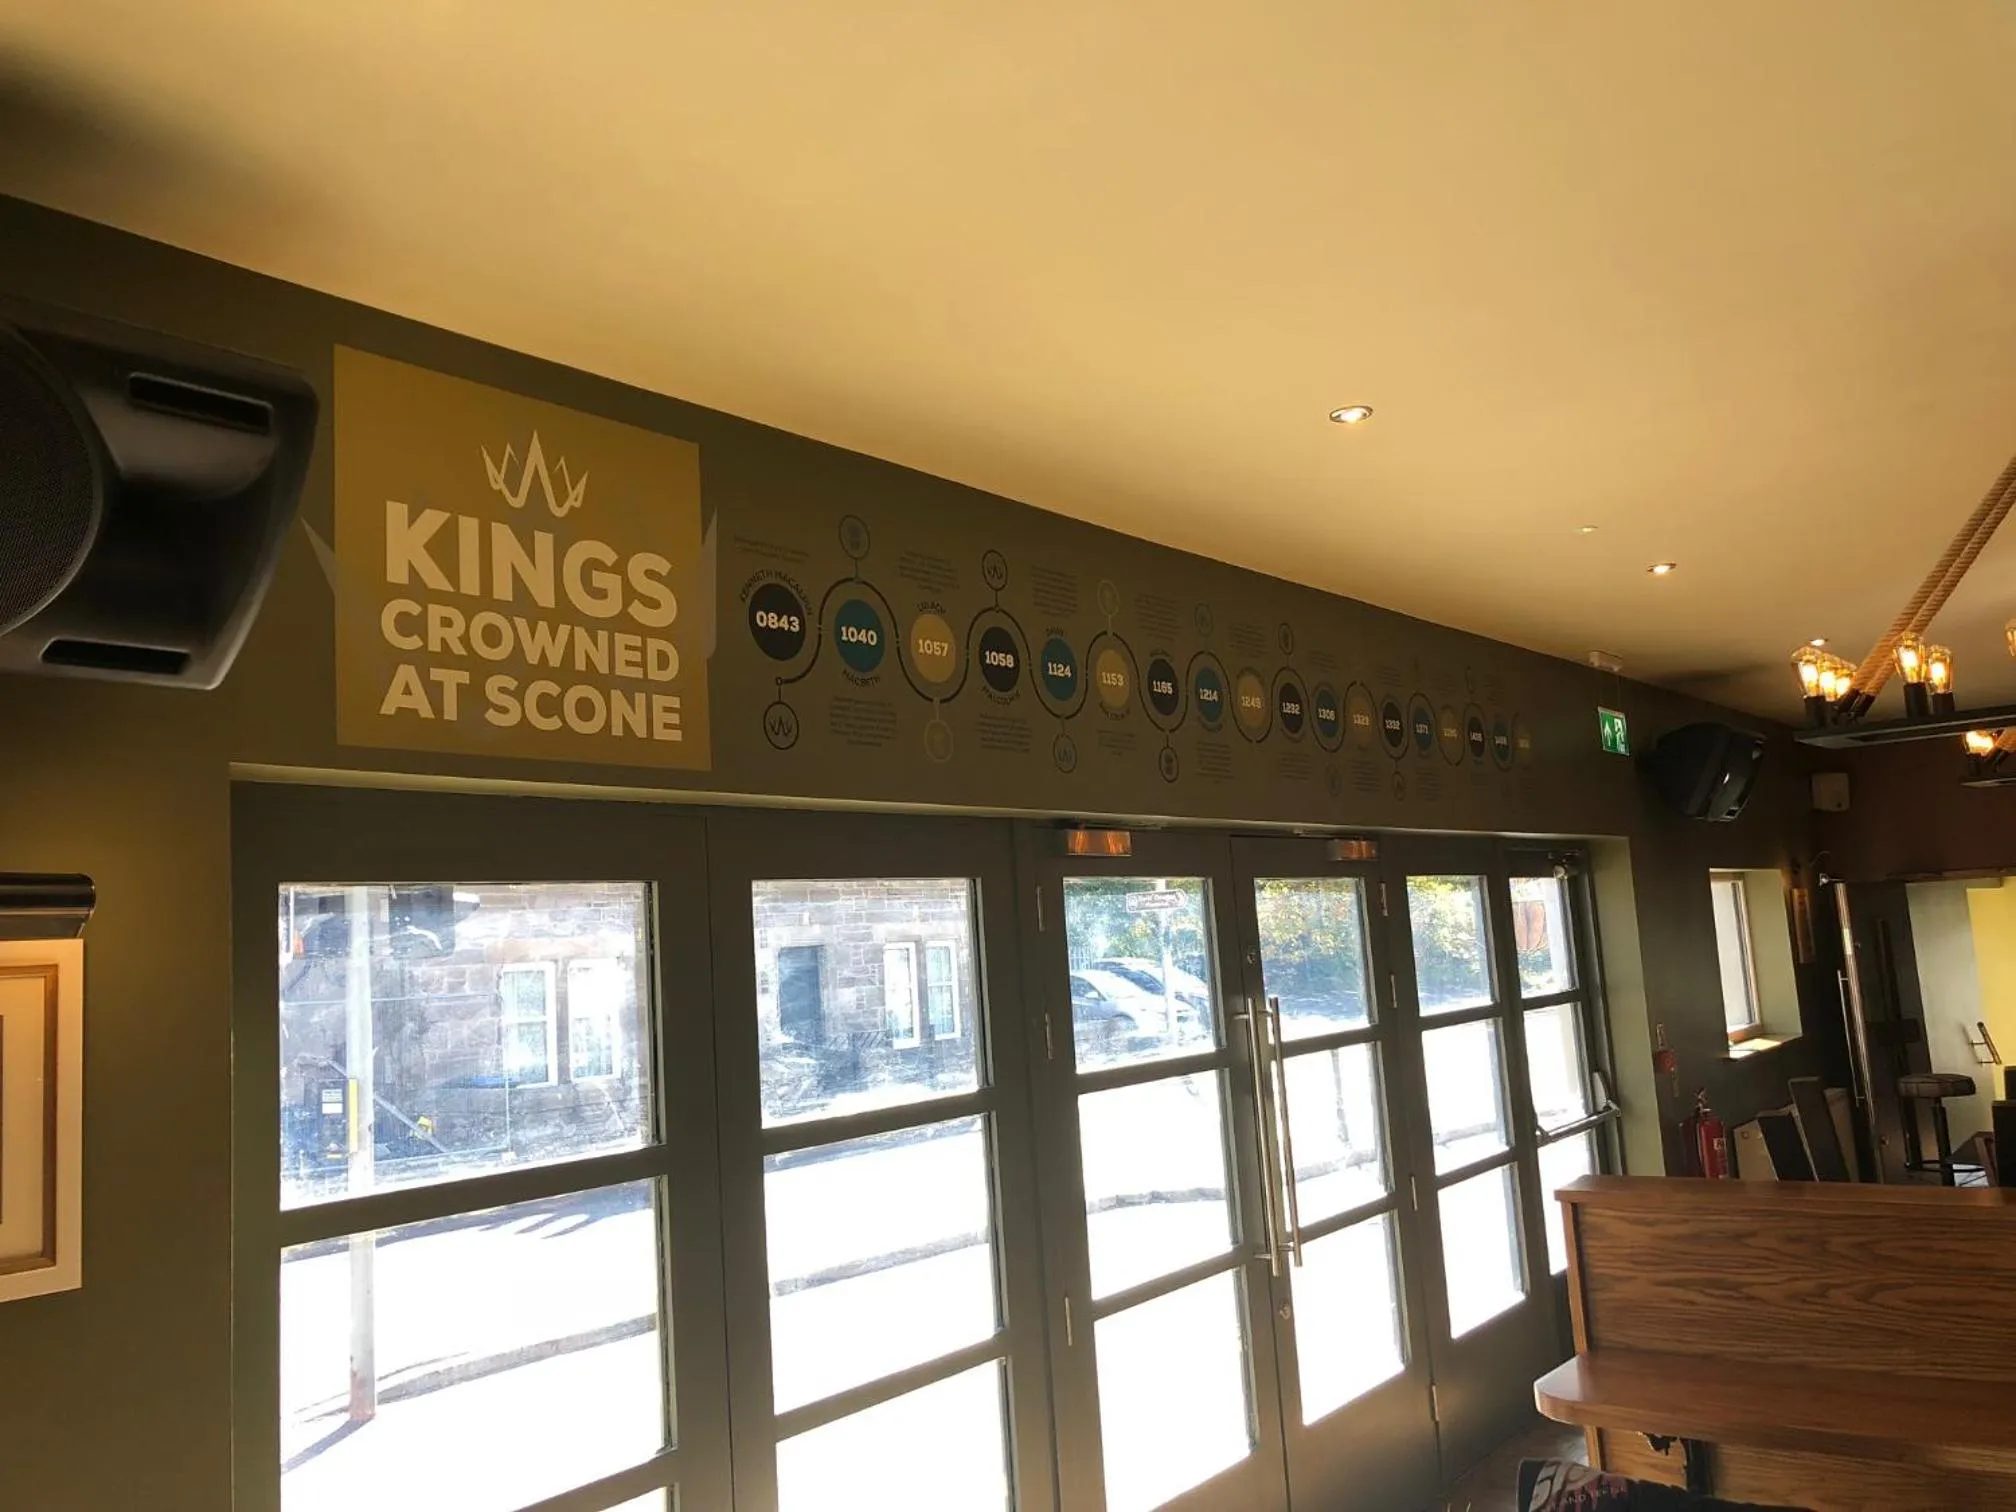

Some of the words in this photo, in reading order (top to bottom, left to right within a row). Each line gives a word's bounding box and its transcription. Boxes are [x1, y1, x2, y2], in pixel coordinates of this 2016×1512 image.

[386, 500, 678, 628] KINGS
[756, 610, 800, 632] 0843
[381, 598, 680, 682] CROWNED
[841, 626, 877, 646] 1040
[918, 639, 949, 657] 1057
[985, 650, 1014, 668] 1058
[1048, 662, 1072, 678] 1124
[1102, 672, 1124, 687] 1153
[379, 664, 470, 721] AT
[484, 674, 683, 742] SCONE
